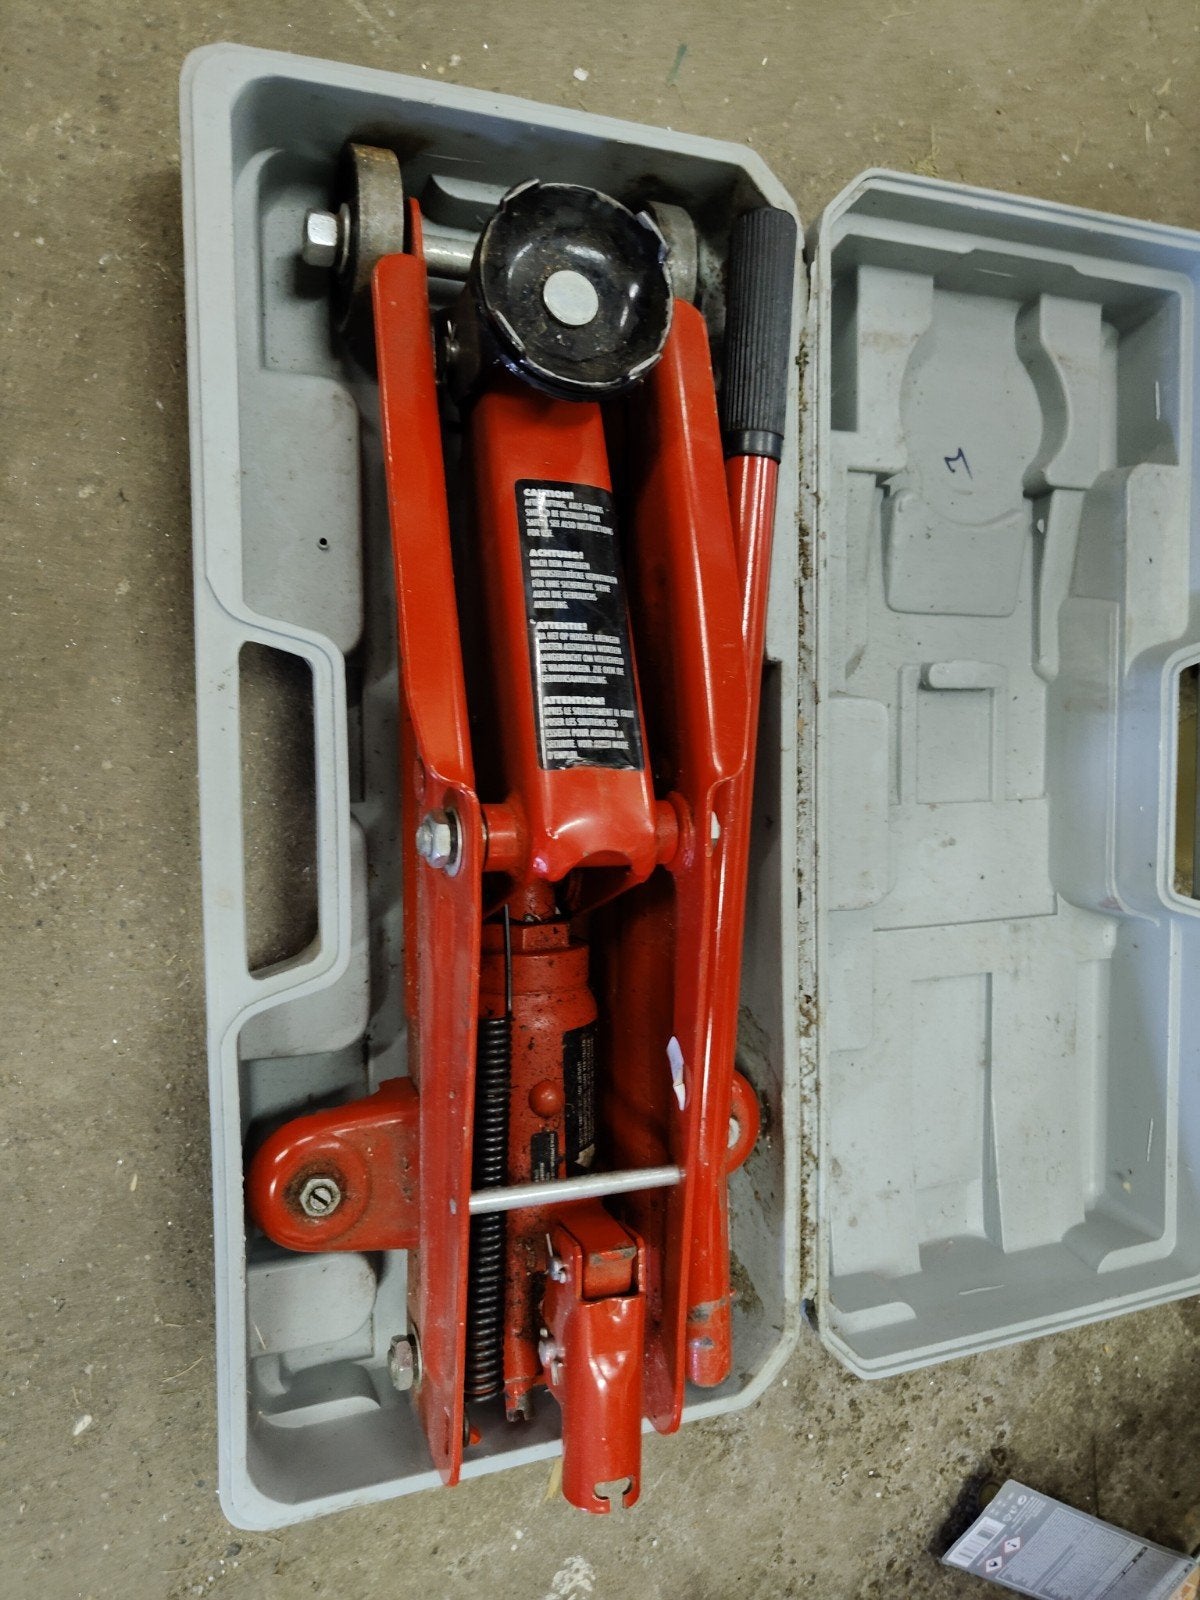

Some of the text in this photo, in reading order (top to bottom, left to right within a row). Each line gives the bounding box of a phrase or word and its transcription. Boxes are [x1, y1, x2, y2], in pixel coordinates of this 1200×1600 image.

[523, 488, 574, 499] CAUTION!
[529, 548, 584, 560] ACHTUNG!
[535, 621, 588, 631] ATTENTIE!
[542, 695, 606, 706] ATTENTION!
